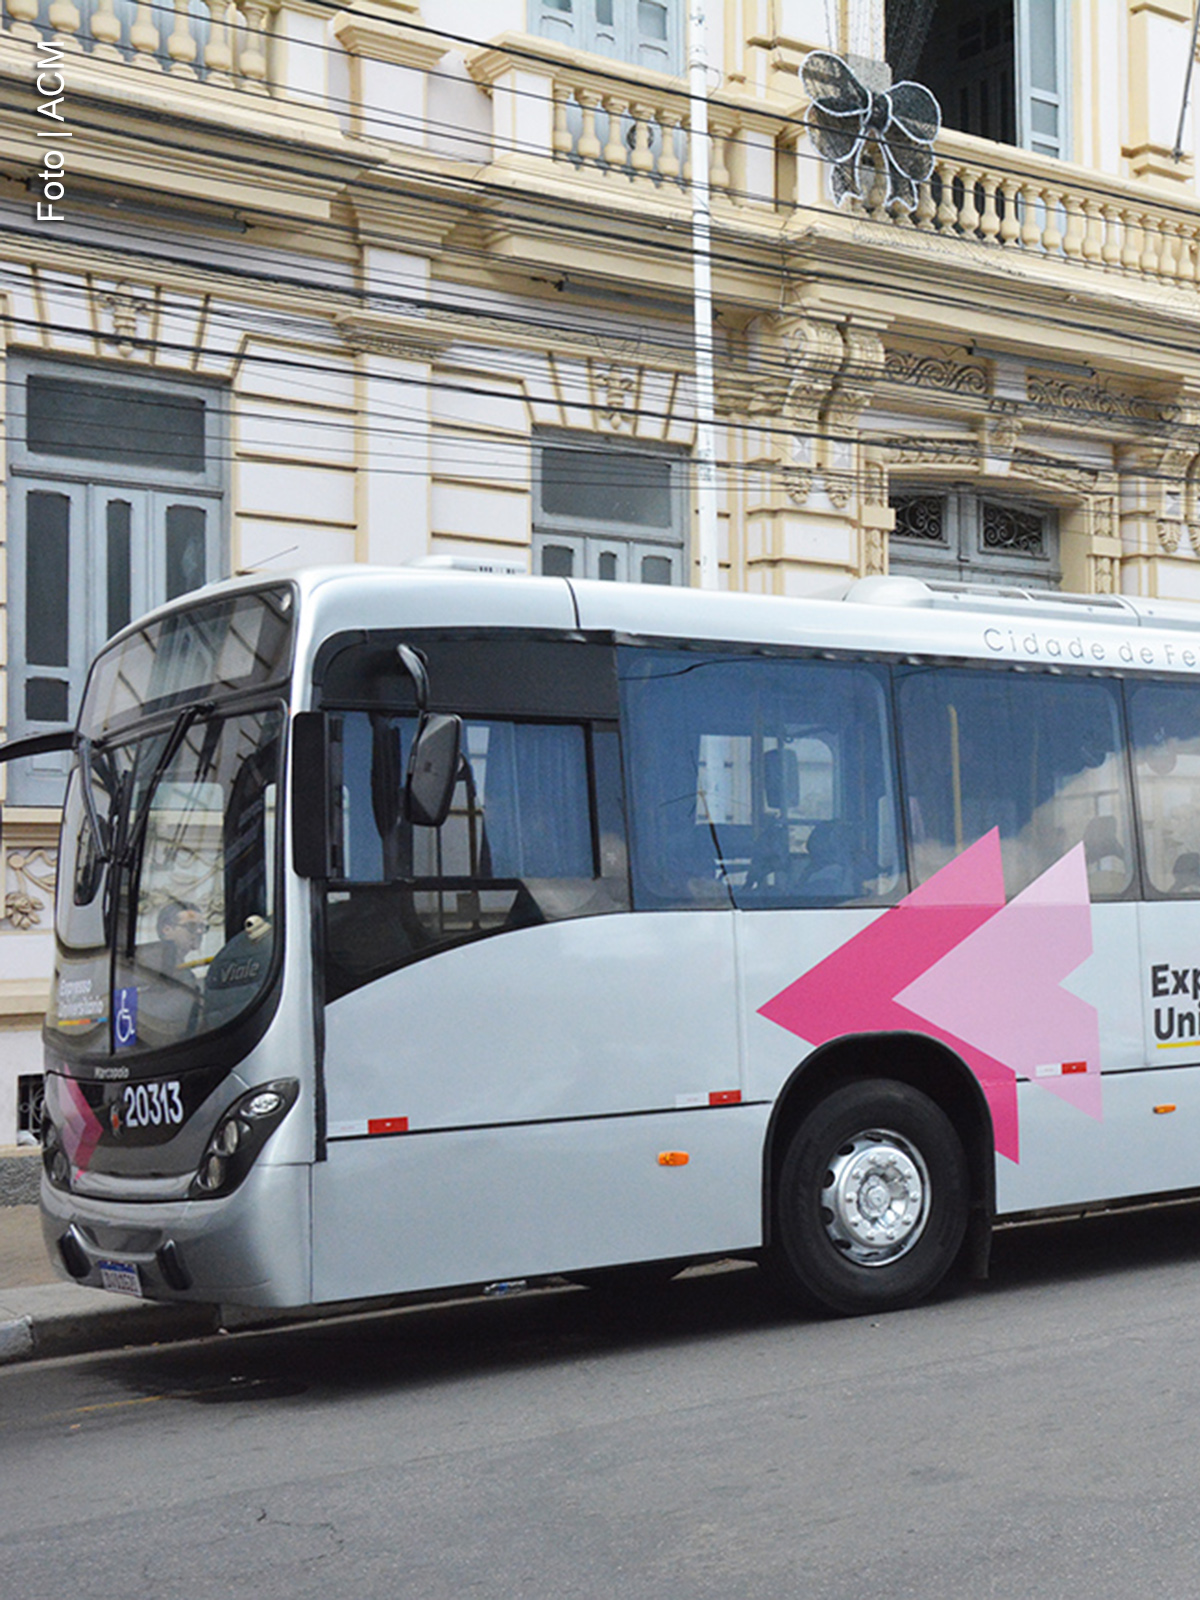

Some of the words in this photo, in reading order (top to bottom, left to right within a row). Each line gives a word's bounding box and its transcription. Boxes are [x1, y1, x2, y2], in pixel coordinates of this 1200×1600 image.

[984, 628, 1105, 660] Cidade
[1119, 641, 1154, 664] de
[220, 957, 260, 982] Viale
[124, 1081, 184, 1128] 20313
